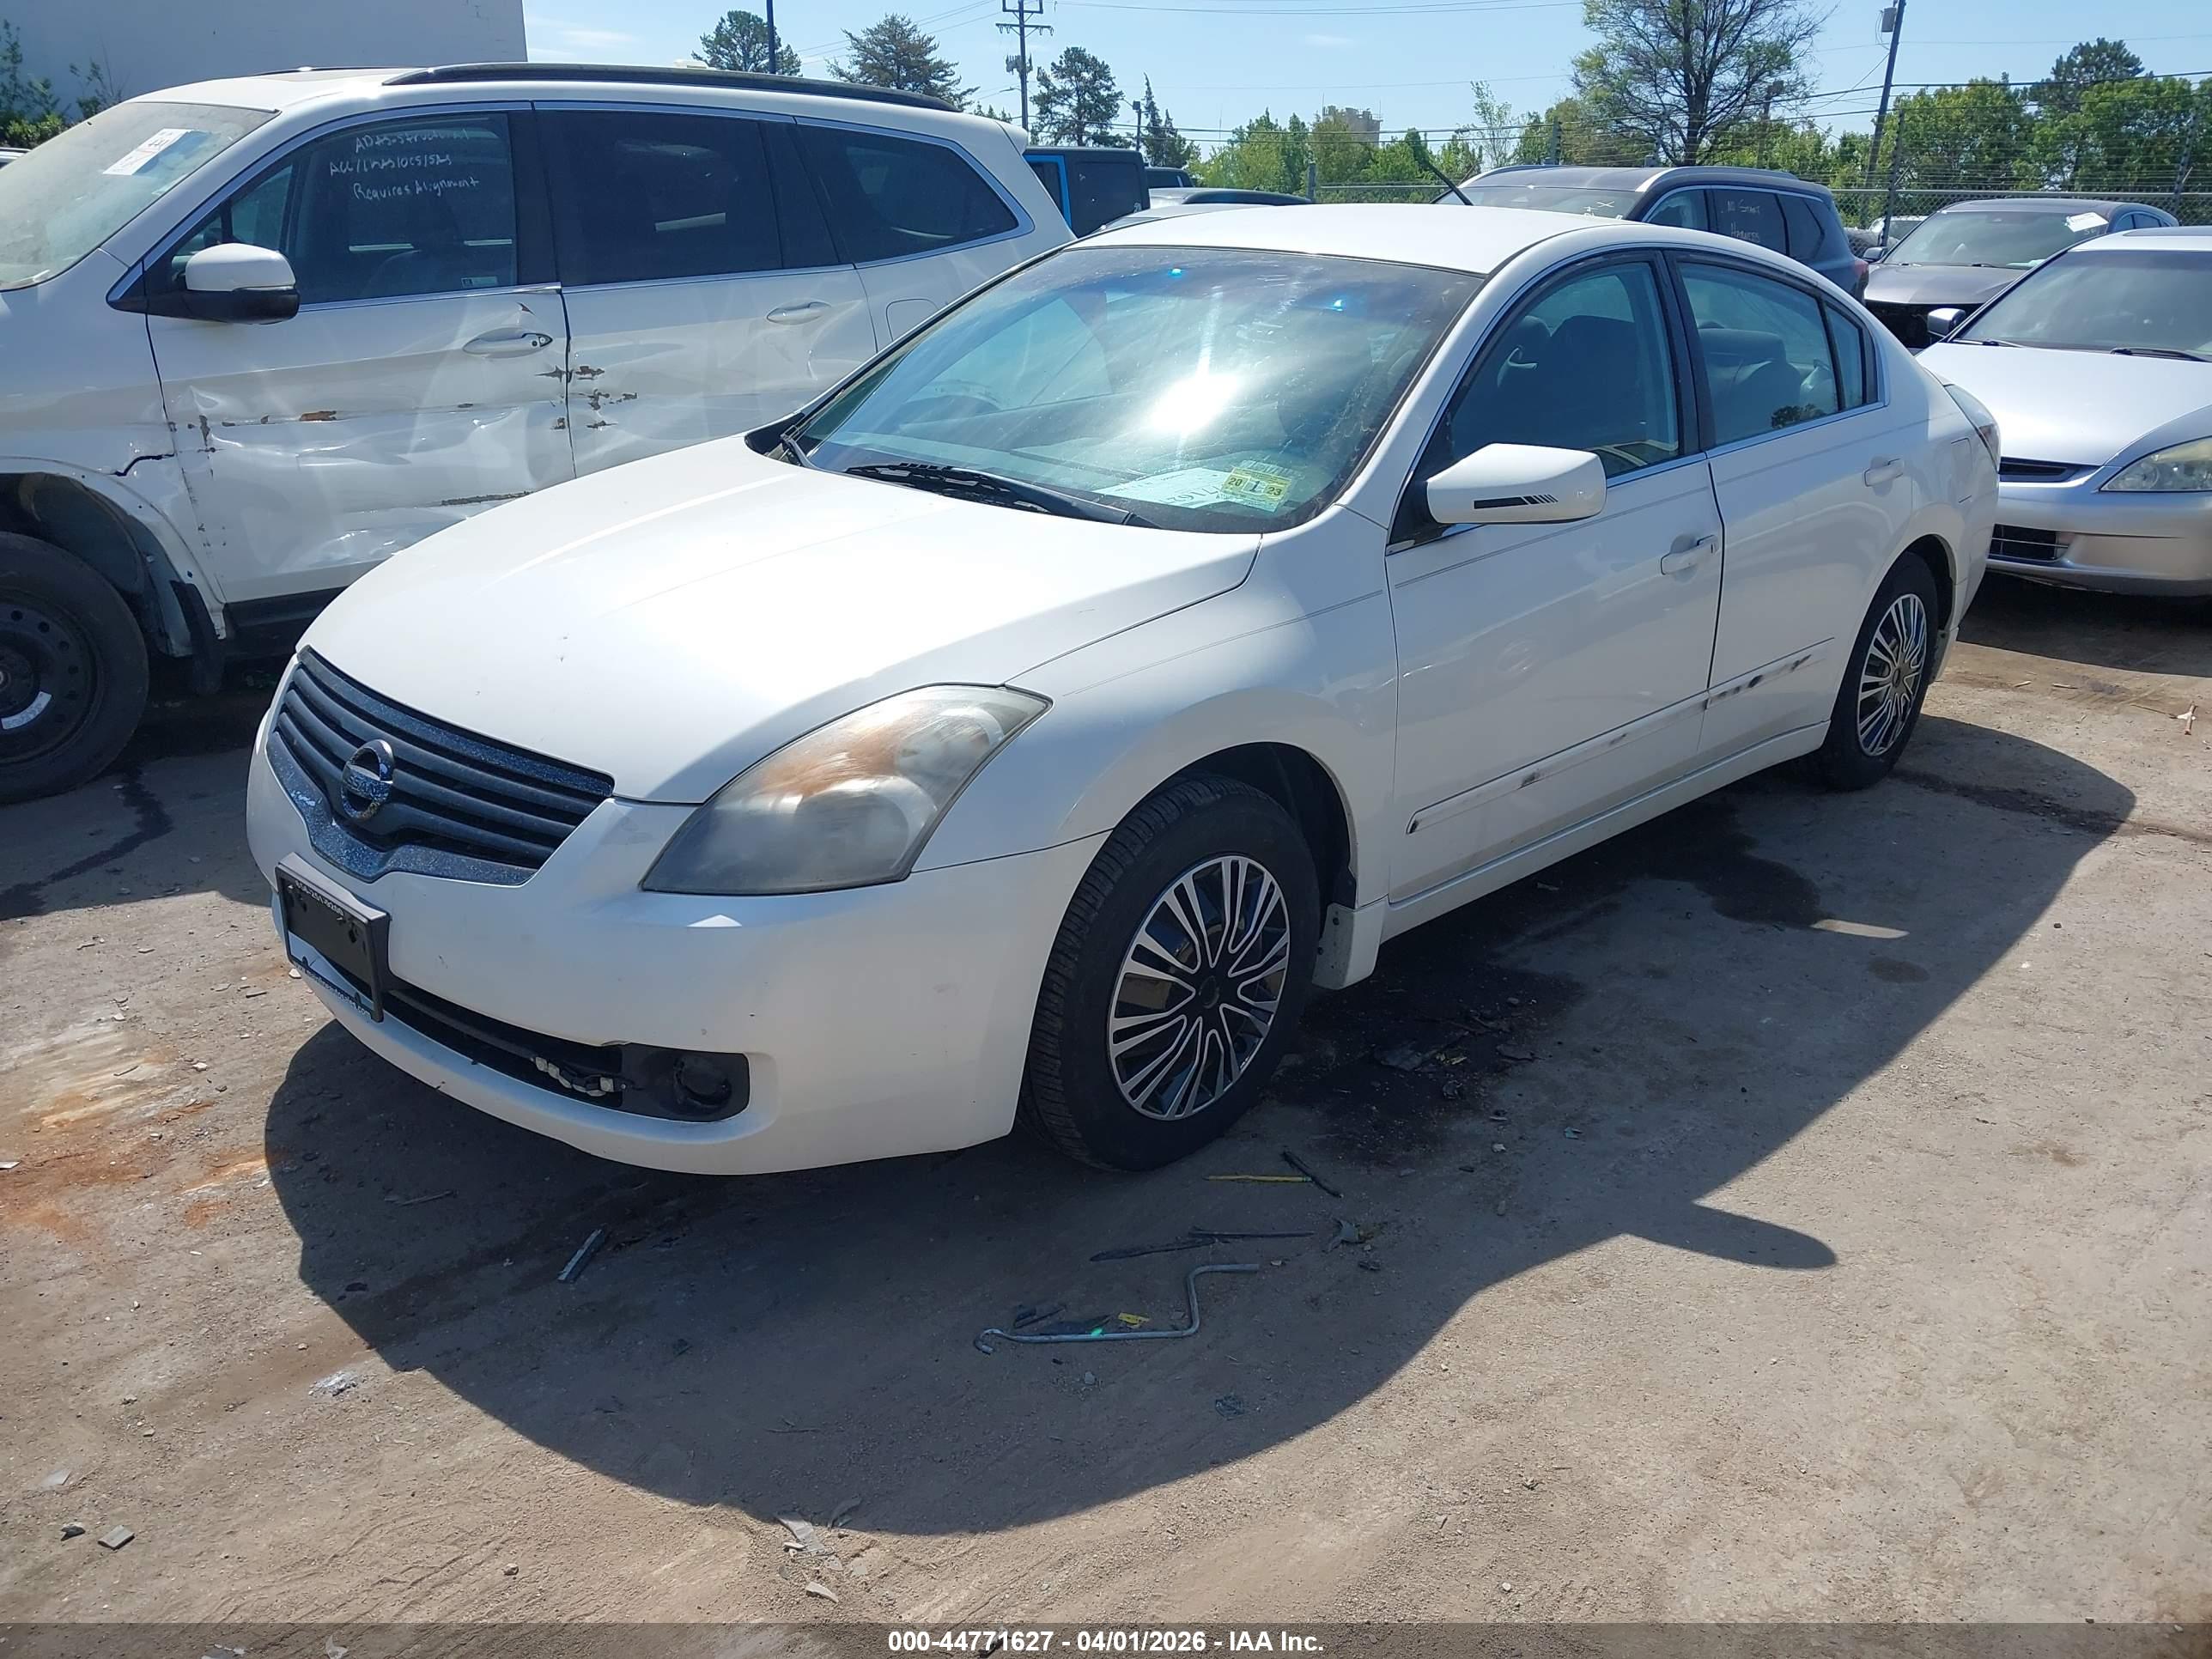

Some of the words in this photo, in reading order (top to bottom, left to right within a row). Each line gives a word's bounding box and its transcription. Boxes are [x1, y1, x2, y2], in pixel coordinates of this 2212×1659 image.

[1228, 477, 1243, 487] 20
[1249, 481, 1261, 492] 1
[1267, 487, 1283, 496] 23
